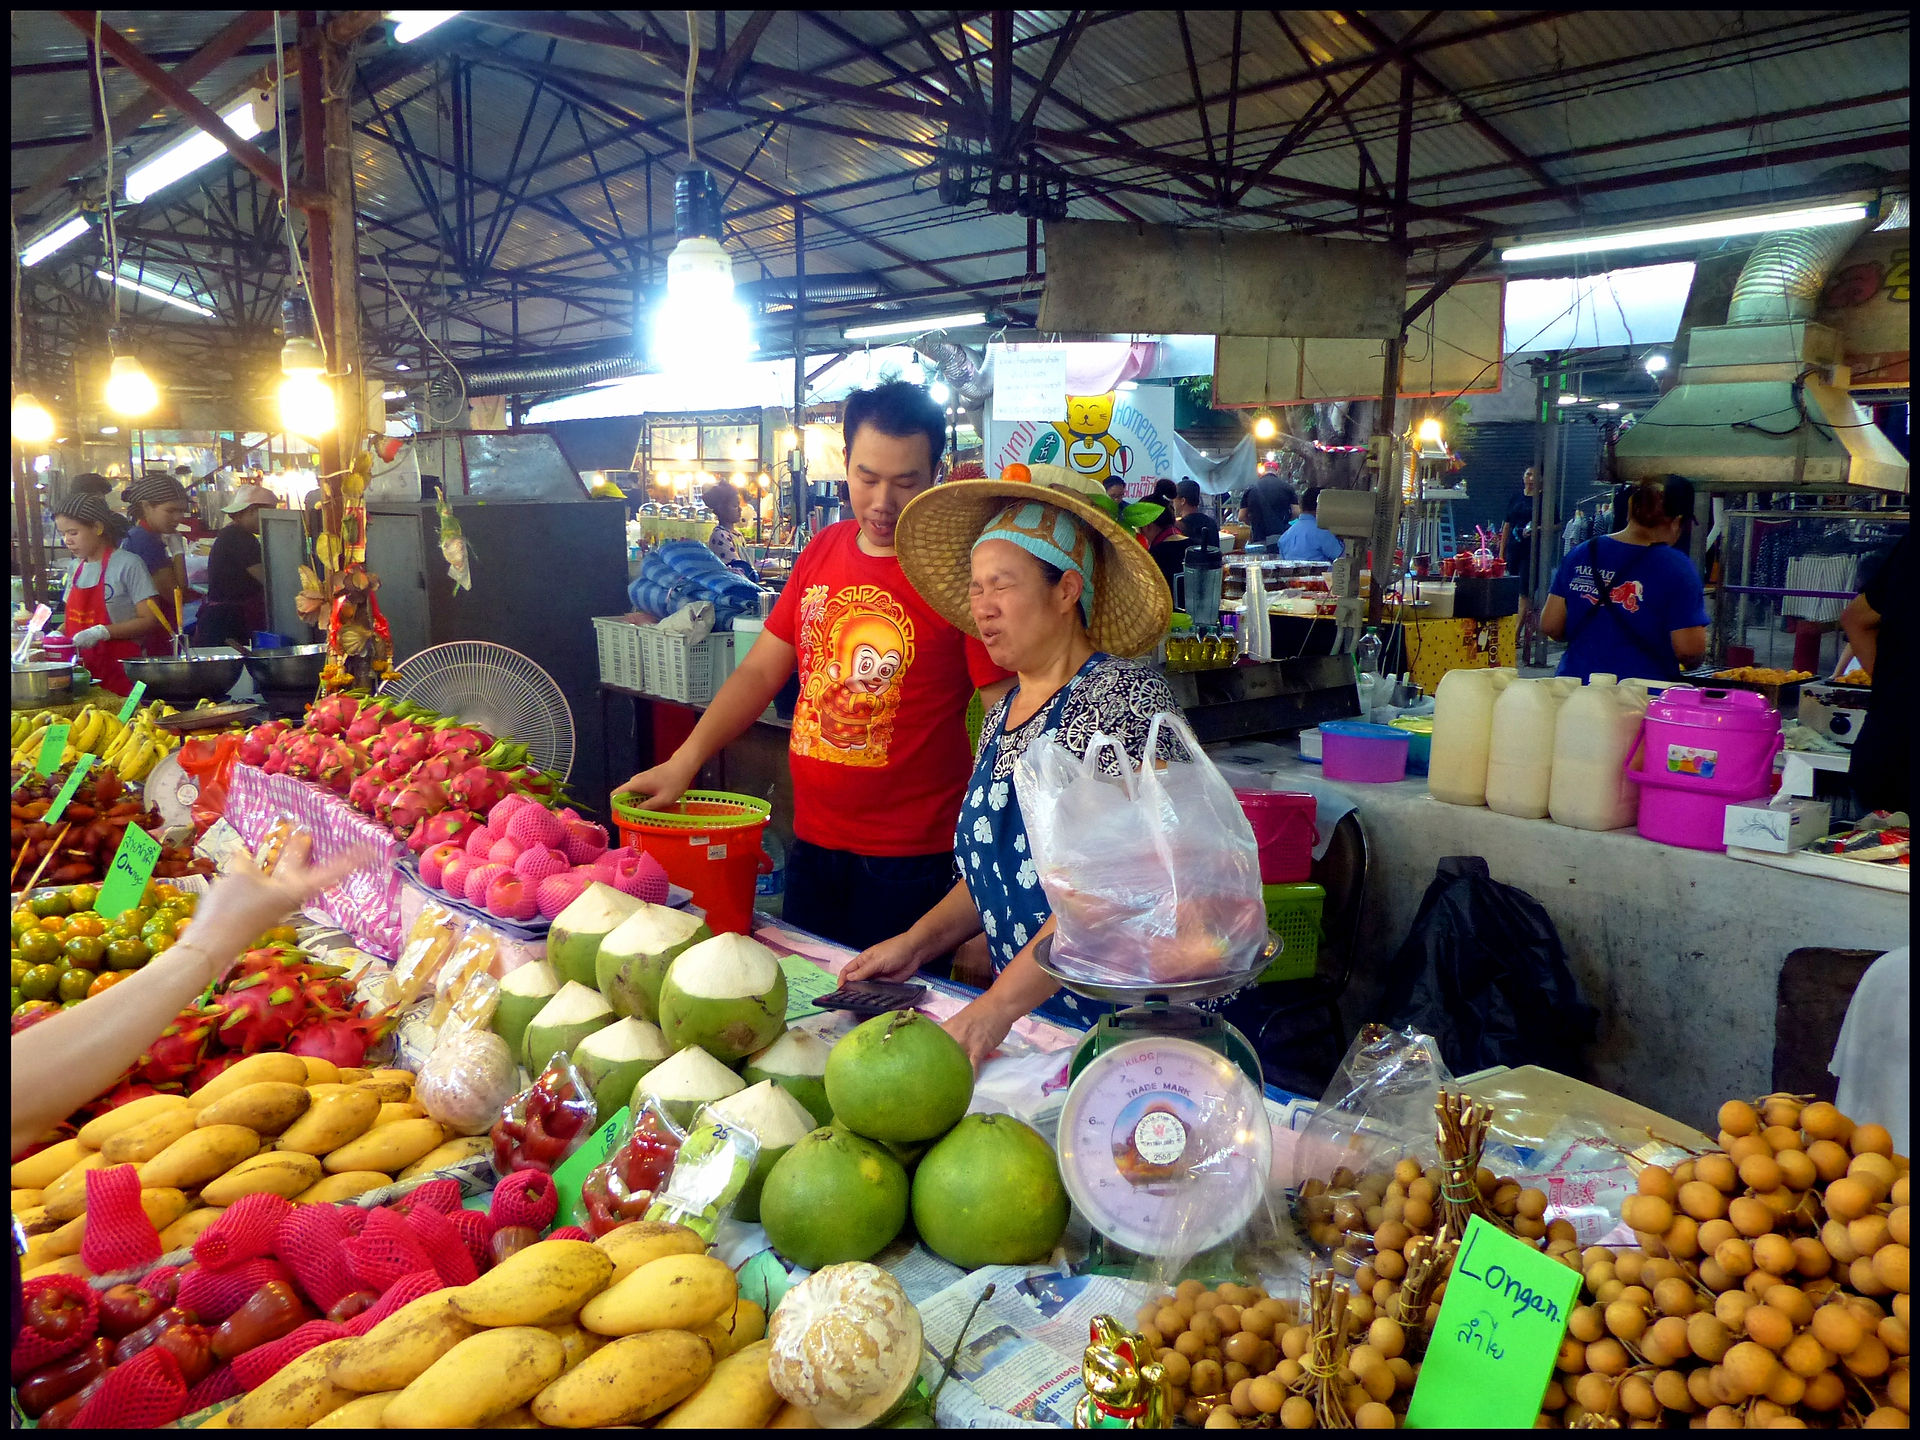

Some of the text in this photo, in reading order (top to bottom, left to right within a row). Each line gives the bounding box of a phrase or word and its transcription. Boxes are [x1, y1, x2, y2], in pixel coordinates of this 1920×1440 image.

[1488, 618, 1499, 663] COFF
[1126, 1082, 1191, 1098] TRADE MARK
[712, 1123, 734, 1140] 25
